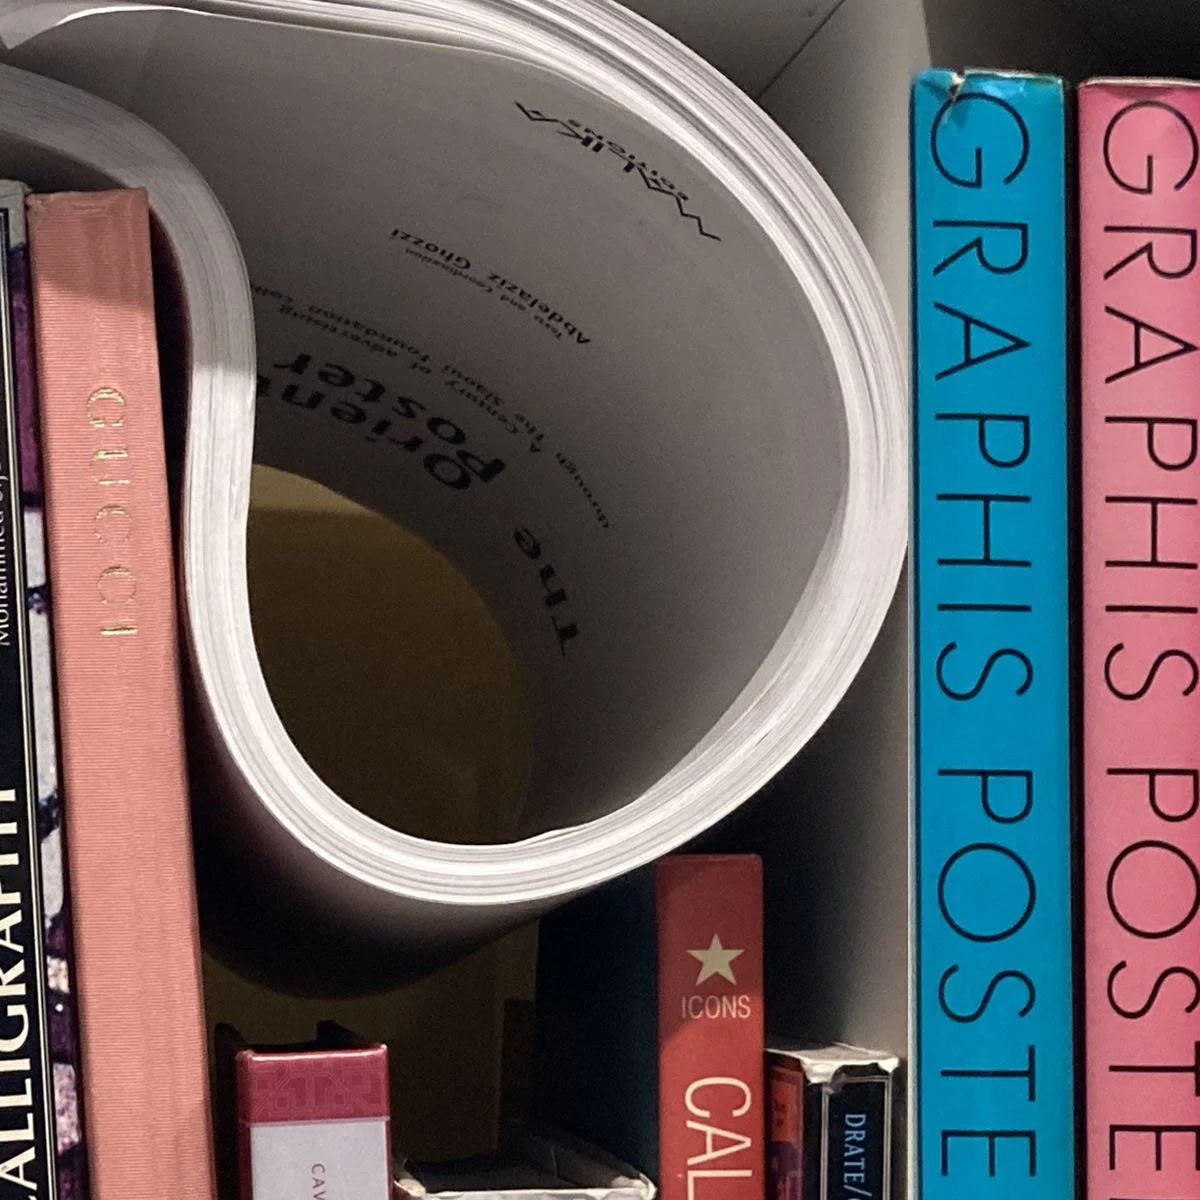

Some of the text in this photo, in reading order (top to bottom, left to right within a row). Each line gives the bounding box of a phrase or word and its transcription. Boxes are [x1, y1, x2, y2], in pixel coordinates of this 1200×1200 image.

[389, 228, 590, 346] Abdelaziz Ghozzi
[273, 353, 506, 483] Poster
[408, 361, 433, 376] of
[931, 92, 1034, 701] GRAPHIS
[1102, 99, 1199, 700] GRAPHIS
[512, 526, 580, 656] The
[680, 994, 752, 1021] ICONS
